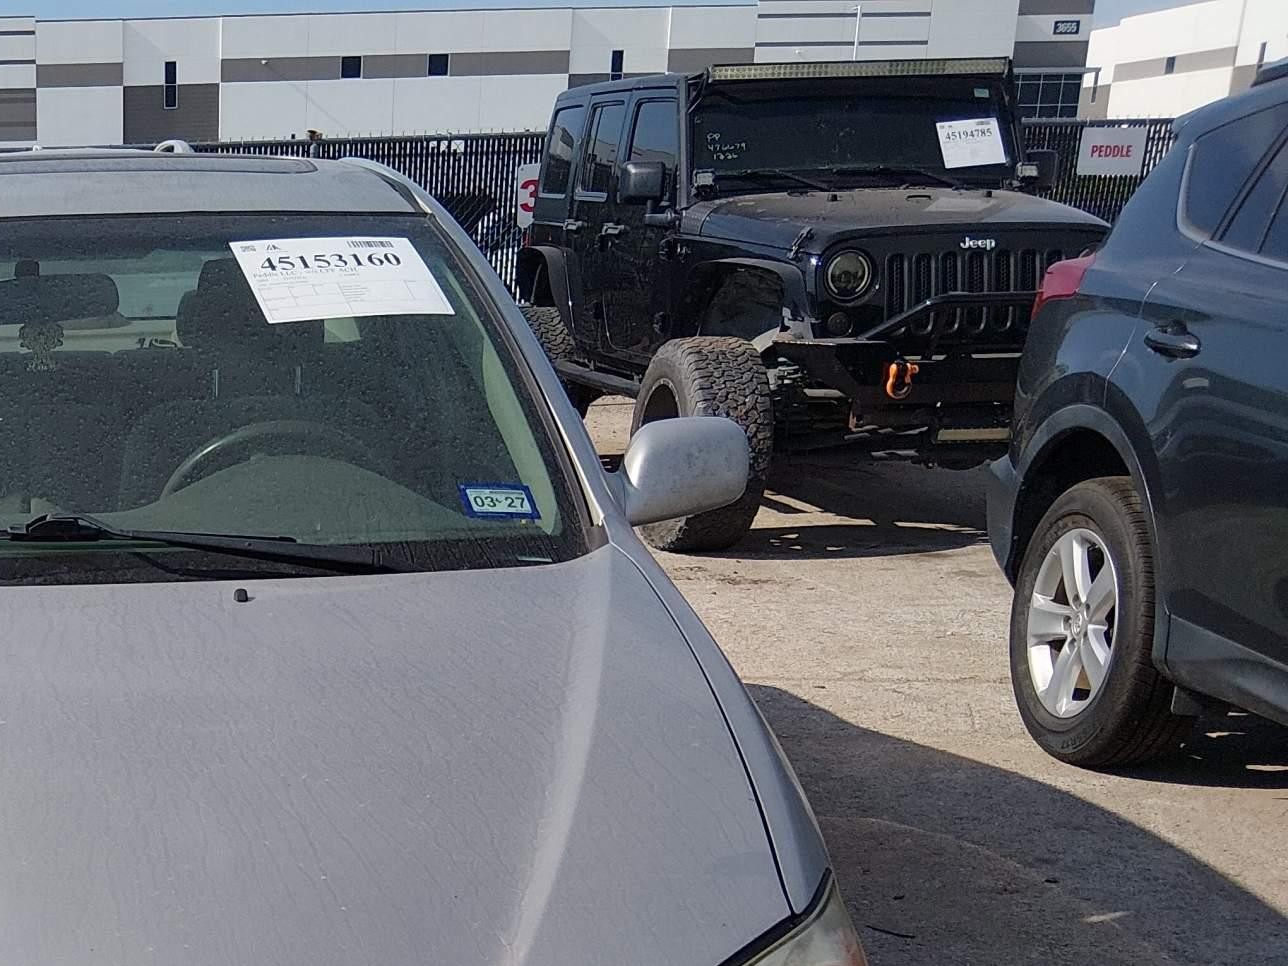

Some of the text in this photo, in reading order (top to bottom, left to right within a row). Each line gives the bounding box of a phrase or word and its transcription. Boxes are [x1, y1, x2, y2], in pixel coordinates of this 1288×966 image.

[945, 128, 993, 141] 45194785
[1091, 144, 1133, 158] PEDDLE
[960, 236, 996, 250] Jeep
[260, 252, 402, 272] 45153160
